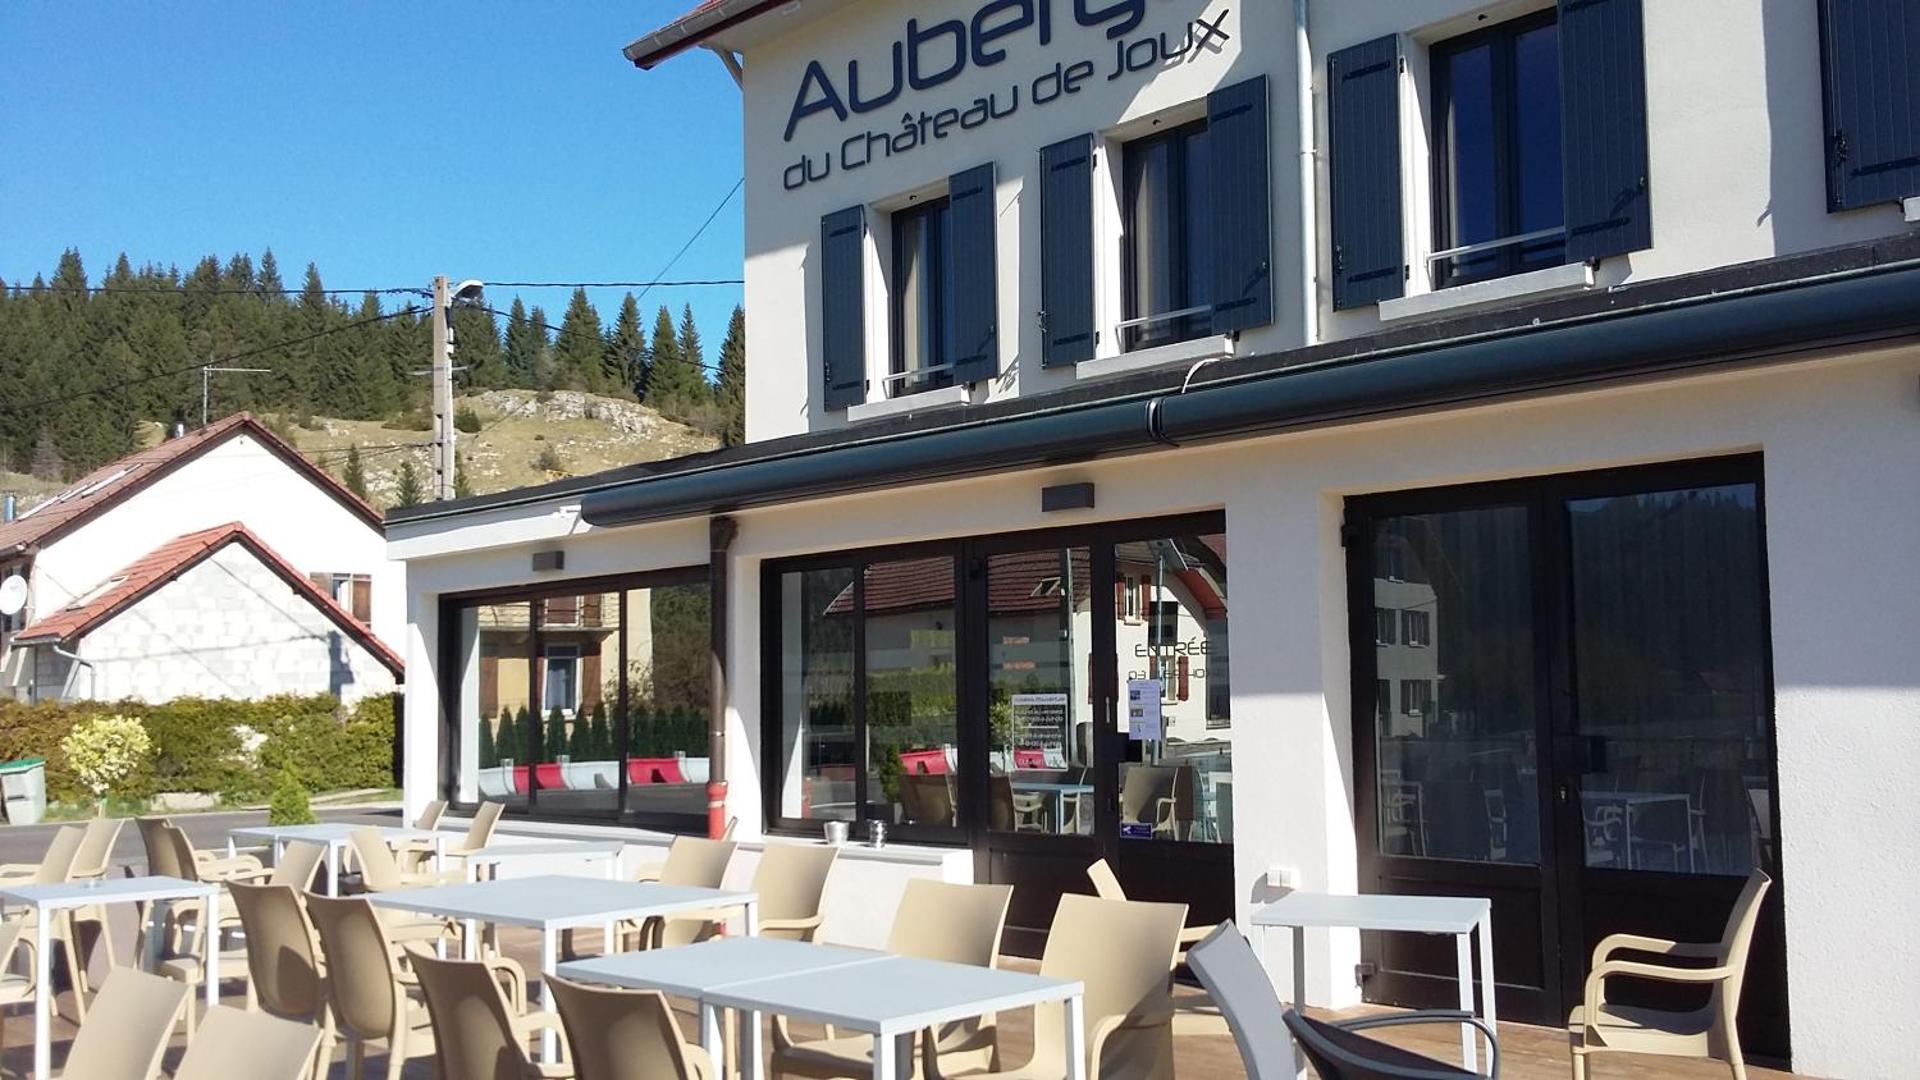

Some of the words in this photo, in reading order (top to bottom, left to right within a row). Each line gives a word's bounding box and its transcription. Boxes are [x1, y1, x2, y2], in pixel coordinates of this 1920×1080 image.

[783, 152, 831, 190] du
[840, 85, 1019, 171] Château
[1031, 61, 1094, 105] de
[1107, 8, 1231, 82] Joux
[784, 0, 1146, 142] Auberg
[1134, 636, 1212, 658] ENTRÉE
